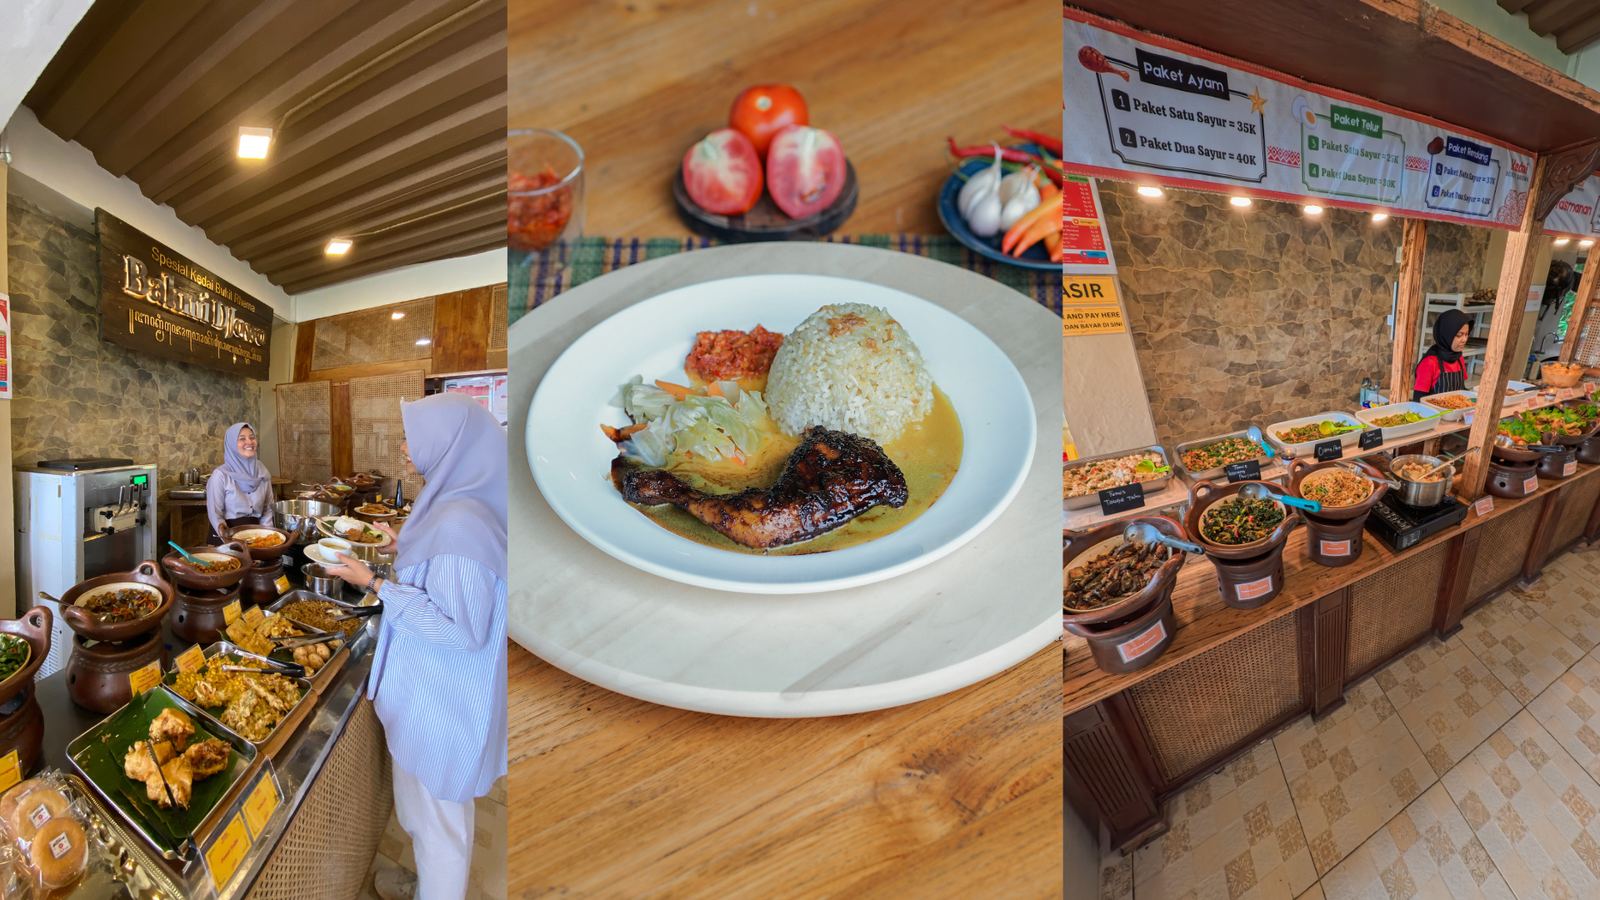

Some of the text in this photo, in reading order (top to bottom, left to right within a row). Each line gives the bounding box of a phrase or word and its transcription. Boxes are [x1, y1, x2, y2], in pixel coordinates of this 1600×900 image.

[1142, 61, 1224, 93] Paket Ayam
[1133, 97, 1167, 117] Paket
[1169, 105, 1195, 121] Satu
[1197, 112, 1227, 130] Sayur
[1237, 121, 1256, 135] 35K
[1334, 113, 1380, 132] Paket Telur
[1140, 136, 1172, 152] Paket
[1175, 142, 1195, 155] Dua
[1198, 146, 1227, 162] Sayur
[1237, 154, 1256, 165] 40K
[1321, 140, 1342, 152] Paket
[1344, 144, 1359, 155] Satu
[1360, 149, 1381, 160] Sayur
[1448, 143, 1467, 154] Paket
[1321, 168, 1341, 179] Paket
[1343, 172, 1356, 182] Dua
[1358, 174, 1377, 185] Sayur
[1444, 166, 1458, 176] Paket
[1440, 189, 1454, 198] Paket
[151, 246, 256, 313] Spesial Kedai Bukit Rhema
